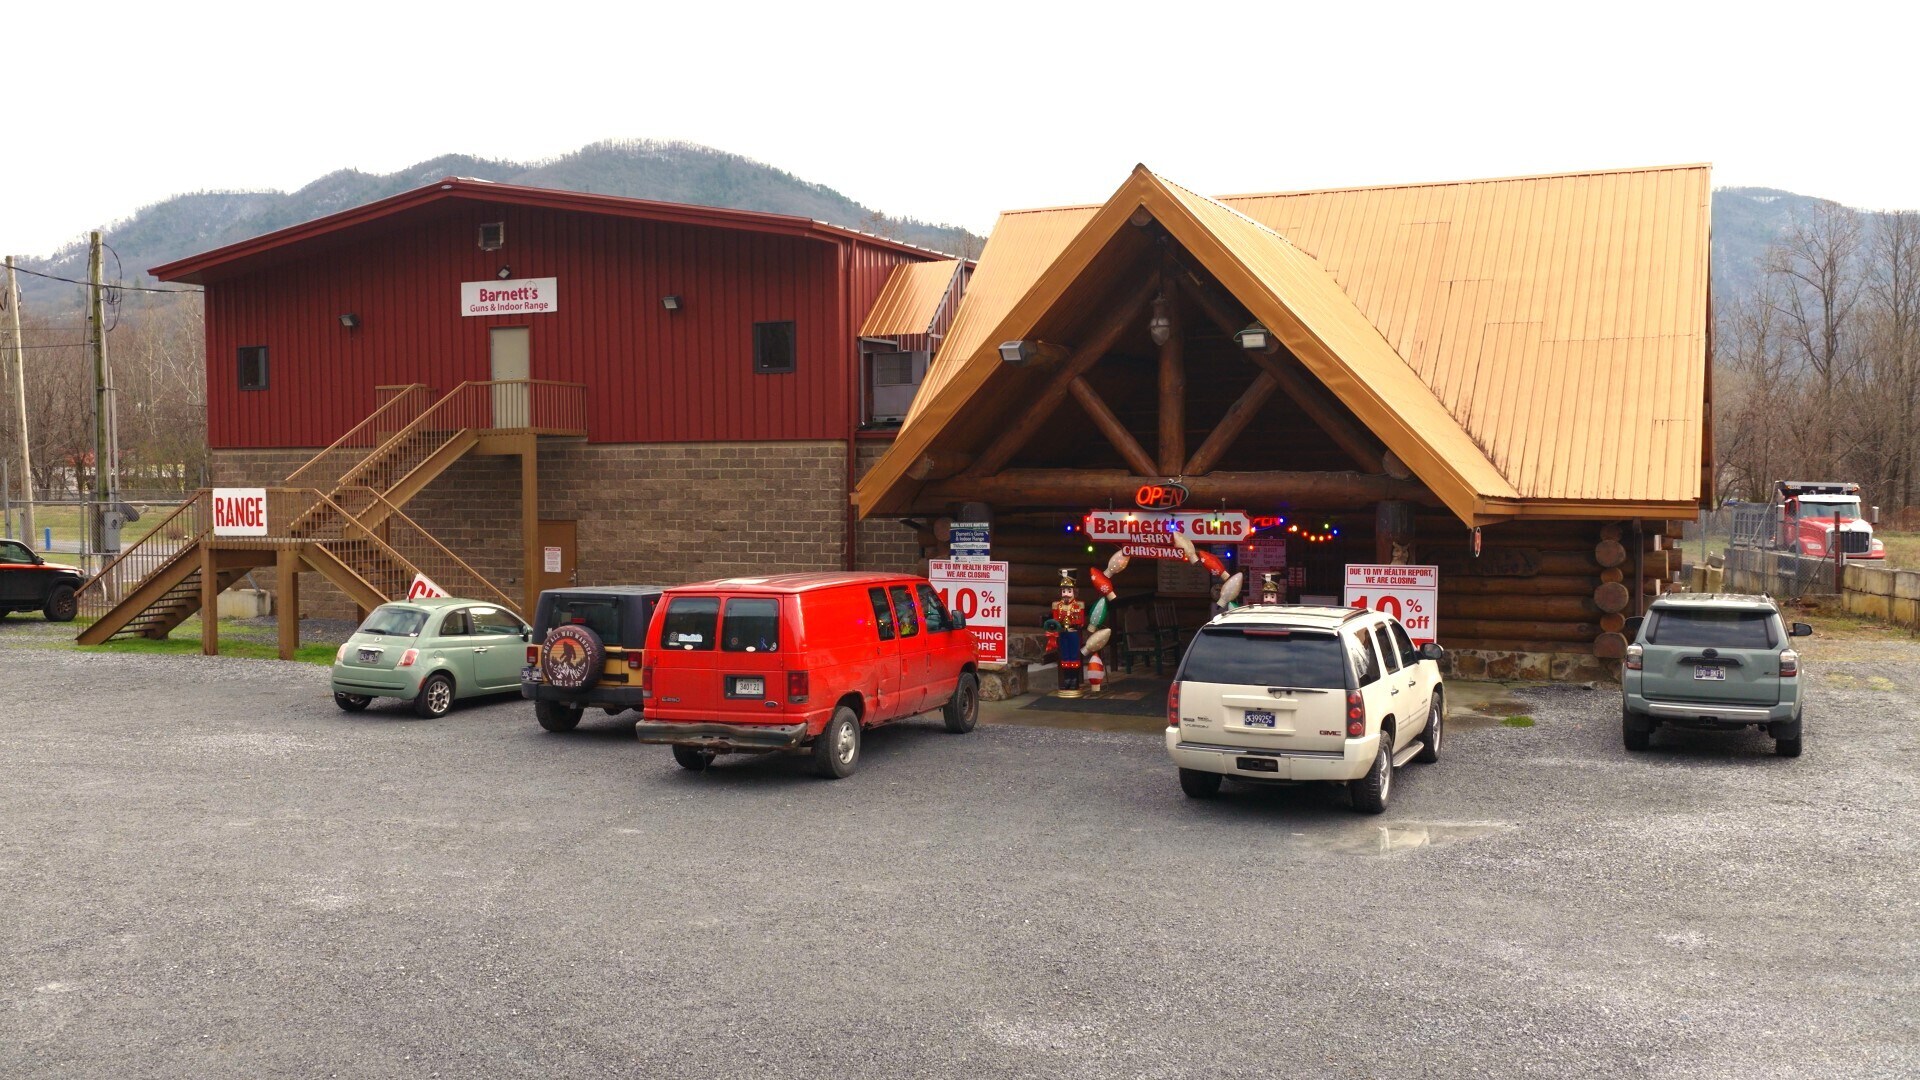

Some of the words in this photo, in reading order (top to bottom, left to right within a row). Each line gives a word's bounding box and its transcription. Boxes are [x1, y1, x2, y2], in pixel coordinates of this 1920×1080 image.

[480, 287, 538, 302] Barnett's
[470, 304, 489, 312] Guns
[490, 303, 496, 311] &
[498, 302, 522, 311] Indoor
[524, 301, 549, 311] Range
[1136, 485, 1184, 507] OPEN
[215, 497, 264, 527] RANGE
[1191, 518, 1243, 536] Guns
[1131, 533, 1172, 543] MERRY
[1122, 545, 1184, 559] CHRISTMAS
[982, 564, 1004, 572] REPORT,
[1384, 568, 1406, 576] HEALTH
[1408, 569, 1433, 577] REPORT,
[981, 606, 1002, 618] off
[1405, 616, 1429, 629] off
[550, 633, 561, 643] ALL
